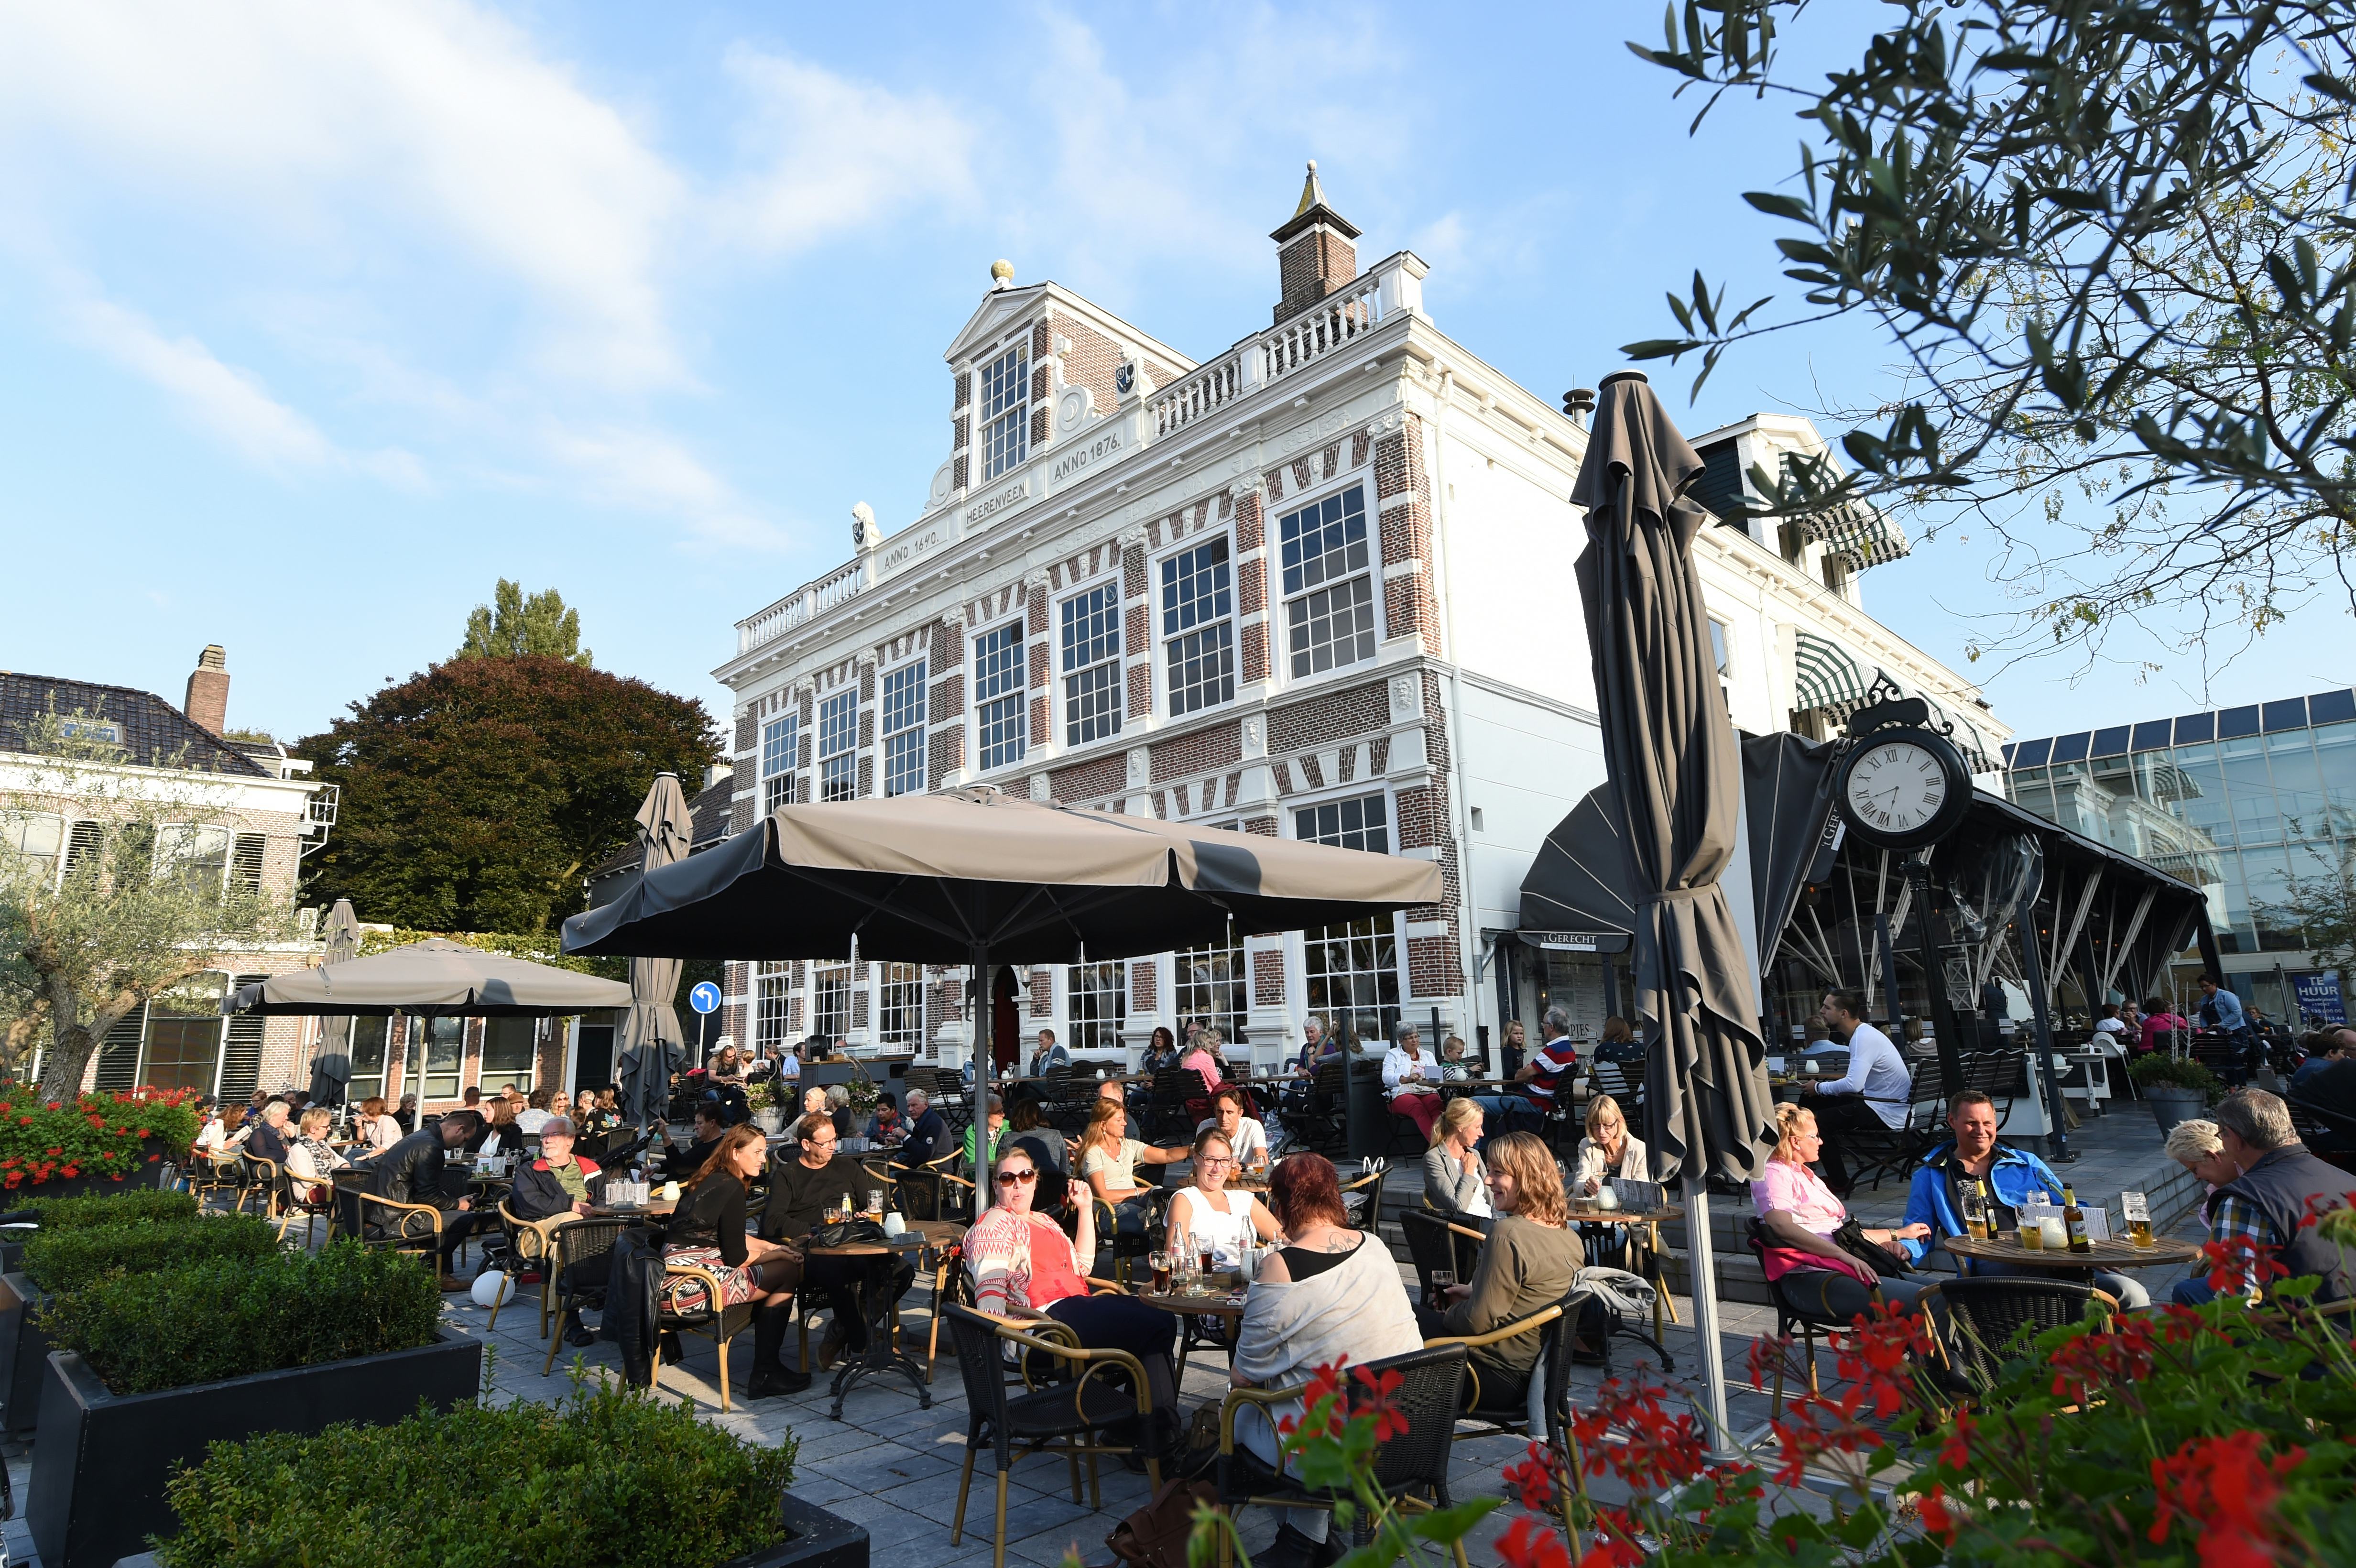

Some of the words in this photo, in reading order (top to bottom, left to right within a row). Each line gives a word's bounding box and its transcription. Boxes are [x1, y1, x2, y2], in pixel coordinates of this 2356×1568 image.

[1055, 451, 1086, 480] ANNO
[1090, 433, 1120, 459] 1876.
[967, 481, 1025, 524] HEERENVEEN
[884, 546, 908, 569] ANNO
[915, 532, 939, 553] 1640.
[1867, 756, 1882, 771] XI
[1884, 749, 1898, 764] XII
[1919, 760, 1932, 773] II
[1857, 773, 1871, 782] X
[1925, 776, 1941, 787] III
[1855, 789, 1870, 800] IX
[1922, 792, 1940, 806] IIII
[1861, 800, 1878, 819] VIII
[1915, 808, 1927, 820] V
[1877, 811, 1890, 827] VII
[1898, 814, 1909, 828] VI
[1549, 933, 1597, 944] GERECHT
[2308, 977, 2324, 986] TE
[2298, 987, 2338, 996] HUUR
